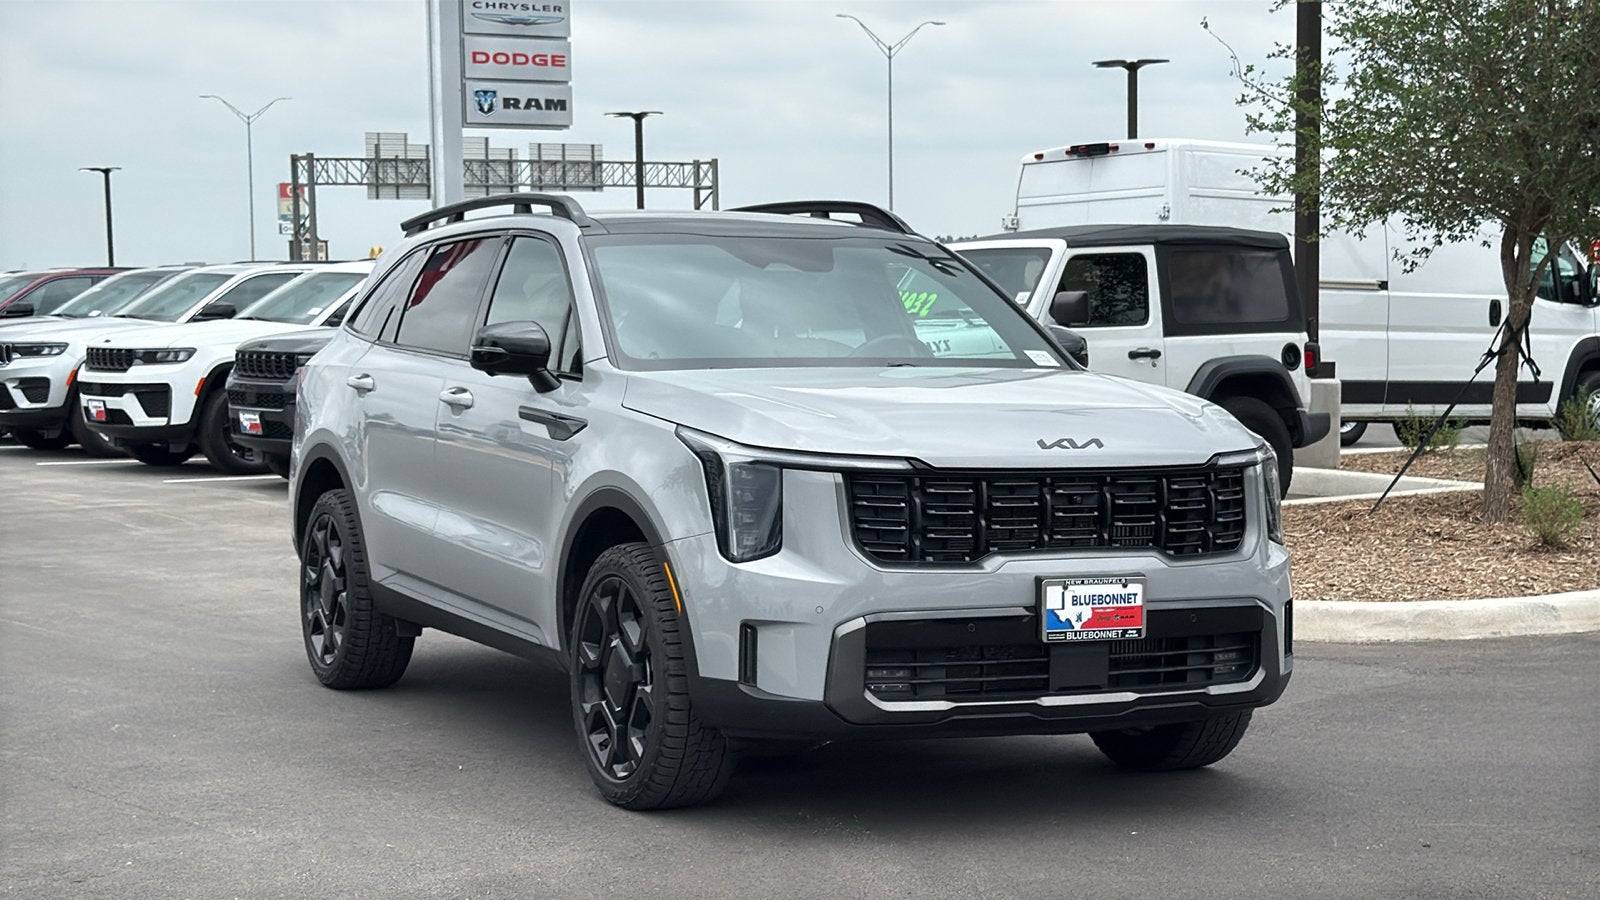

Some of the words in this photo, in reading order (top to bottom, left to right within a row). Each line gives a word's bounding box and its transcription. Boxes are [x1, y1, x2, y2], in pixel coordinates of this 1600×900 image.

[472, 1, 562, 13] CHRYSLER
[471, 51, 566, 67] DODGE
[502, 97, 567, 111] RAM
[1037, 438, 1104, 449] KIA
[1071, 593, 1138, 606] BLUEBONNET
[1066, 630, 1122, 639] BLUEBONNET
